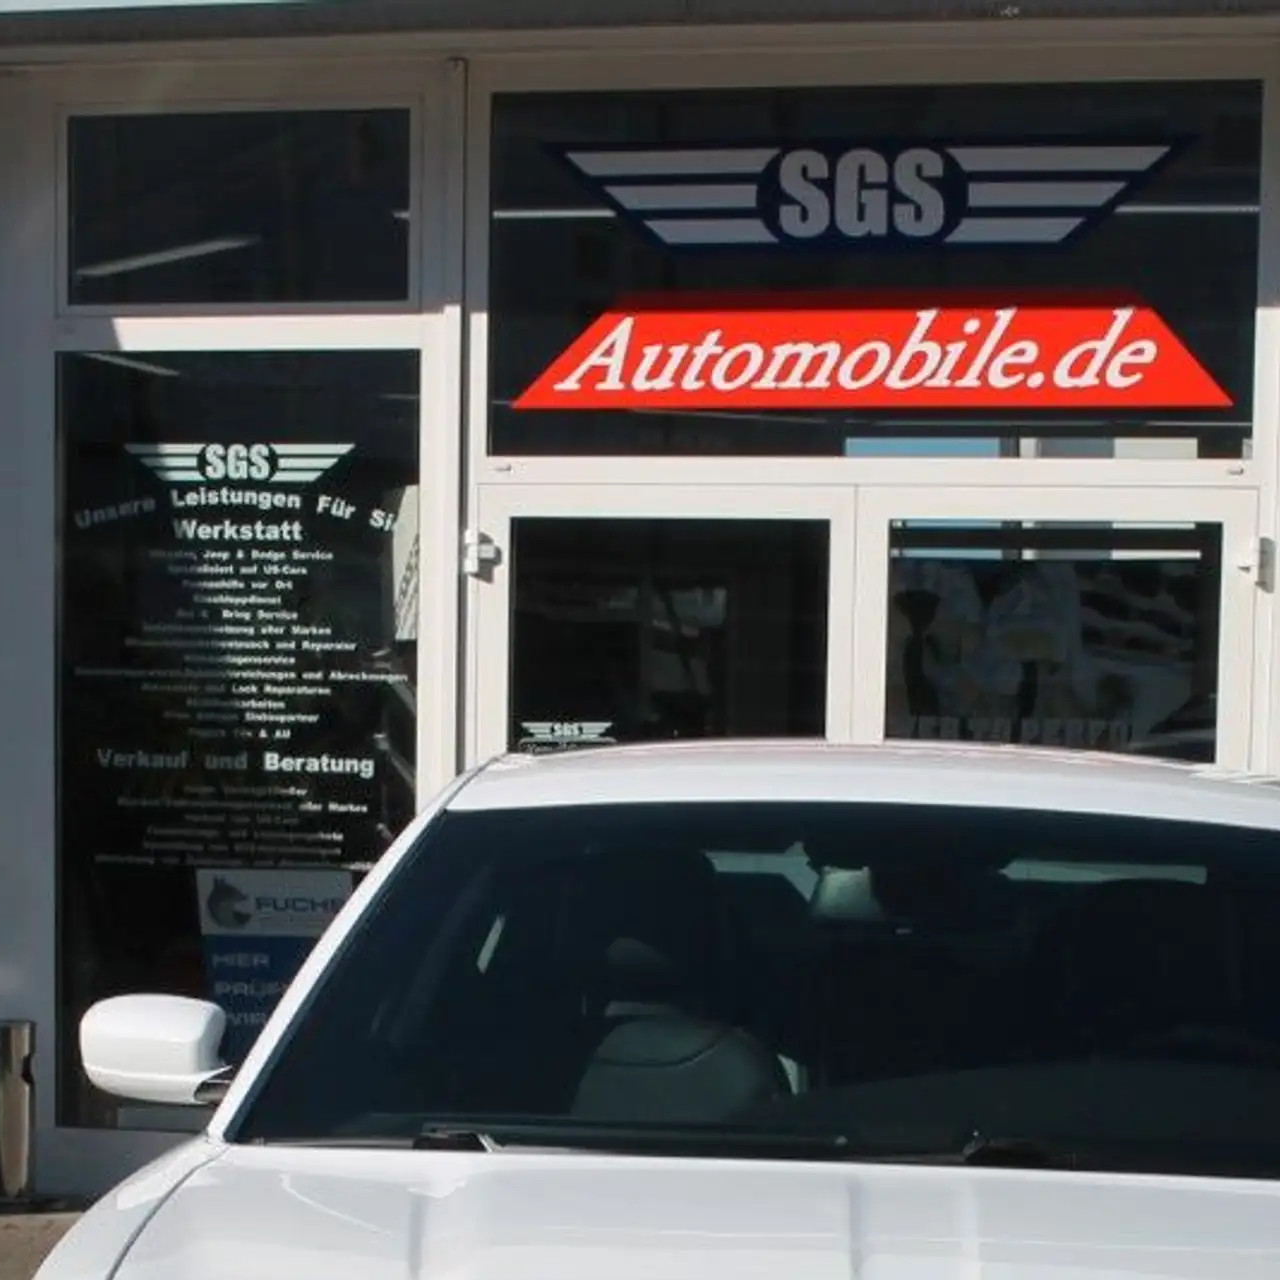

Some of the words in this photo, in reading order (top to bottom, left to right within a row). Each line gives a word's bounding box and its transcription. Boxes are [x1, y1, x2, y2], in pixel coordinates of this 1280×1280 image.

[779, 147, 945, 238] SGS
[554, 306, 1158, 391] Automobile.de
[205, 444, 270, 480] SGS
[171, 488, 301, 510] Leistungen
[317, 495, 356, 520] Für
[370, 510, 396, 533] Si
[174, 520, 302, 541] Werkstatt
[97, 749, 188, 769] Verkauf
[204, 751, 248, 770] und
[264, 753, 376, 779] Beratung
[255, 896, 342, 912] FUCH
[214, 981, 289, 998] PRÜF
